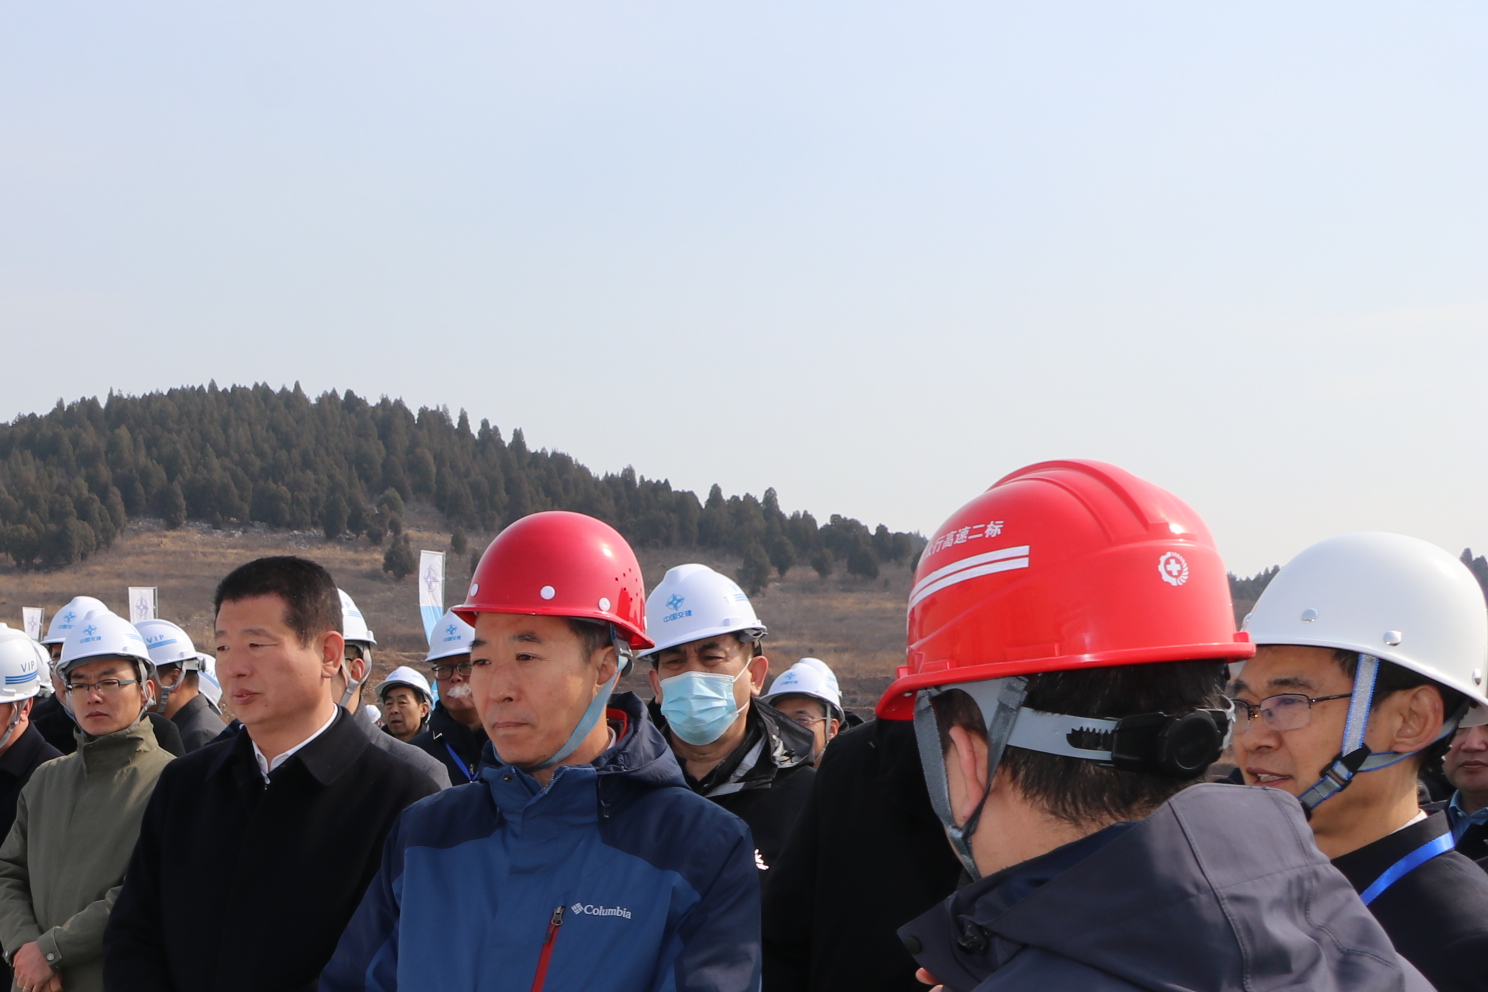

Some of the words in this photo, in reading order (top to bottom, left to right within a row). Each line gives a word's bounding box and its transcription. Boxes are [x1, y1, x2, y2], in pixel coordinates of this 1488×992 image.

[662, 609, 693, 623] 中国交建
[79, 635, 102, 644] 中国交建
[146, 634, 165, 644] VIP
[20, 660, 35, 673] VIP
[583, 904, 632, 920] Columbia
